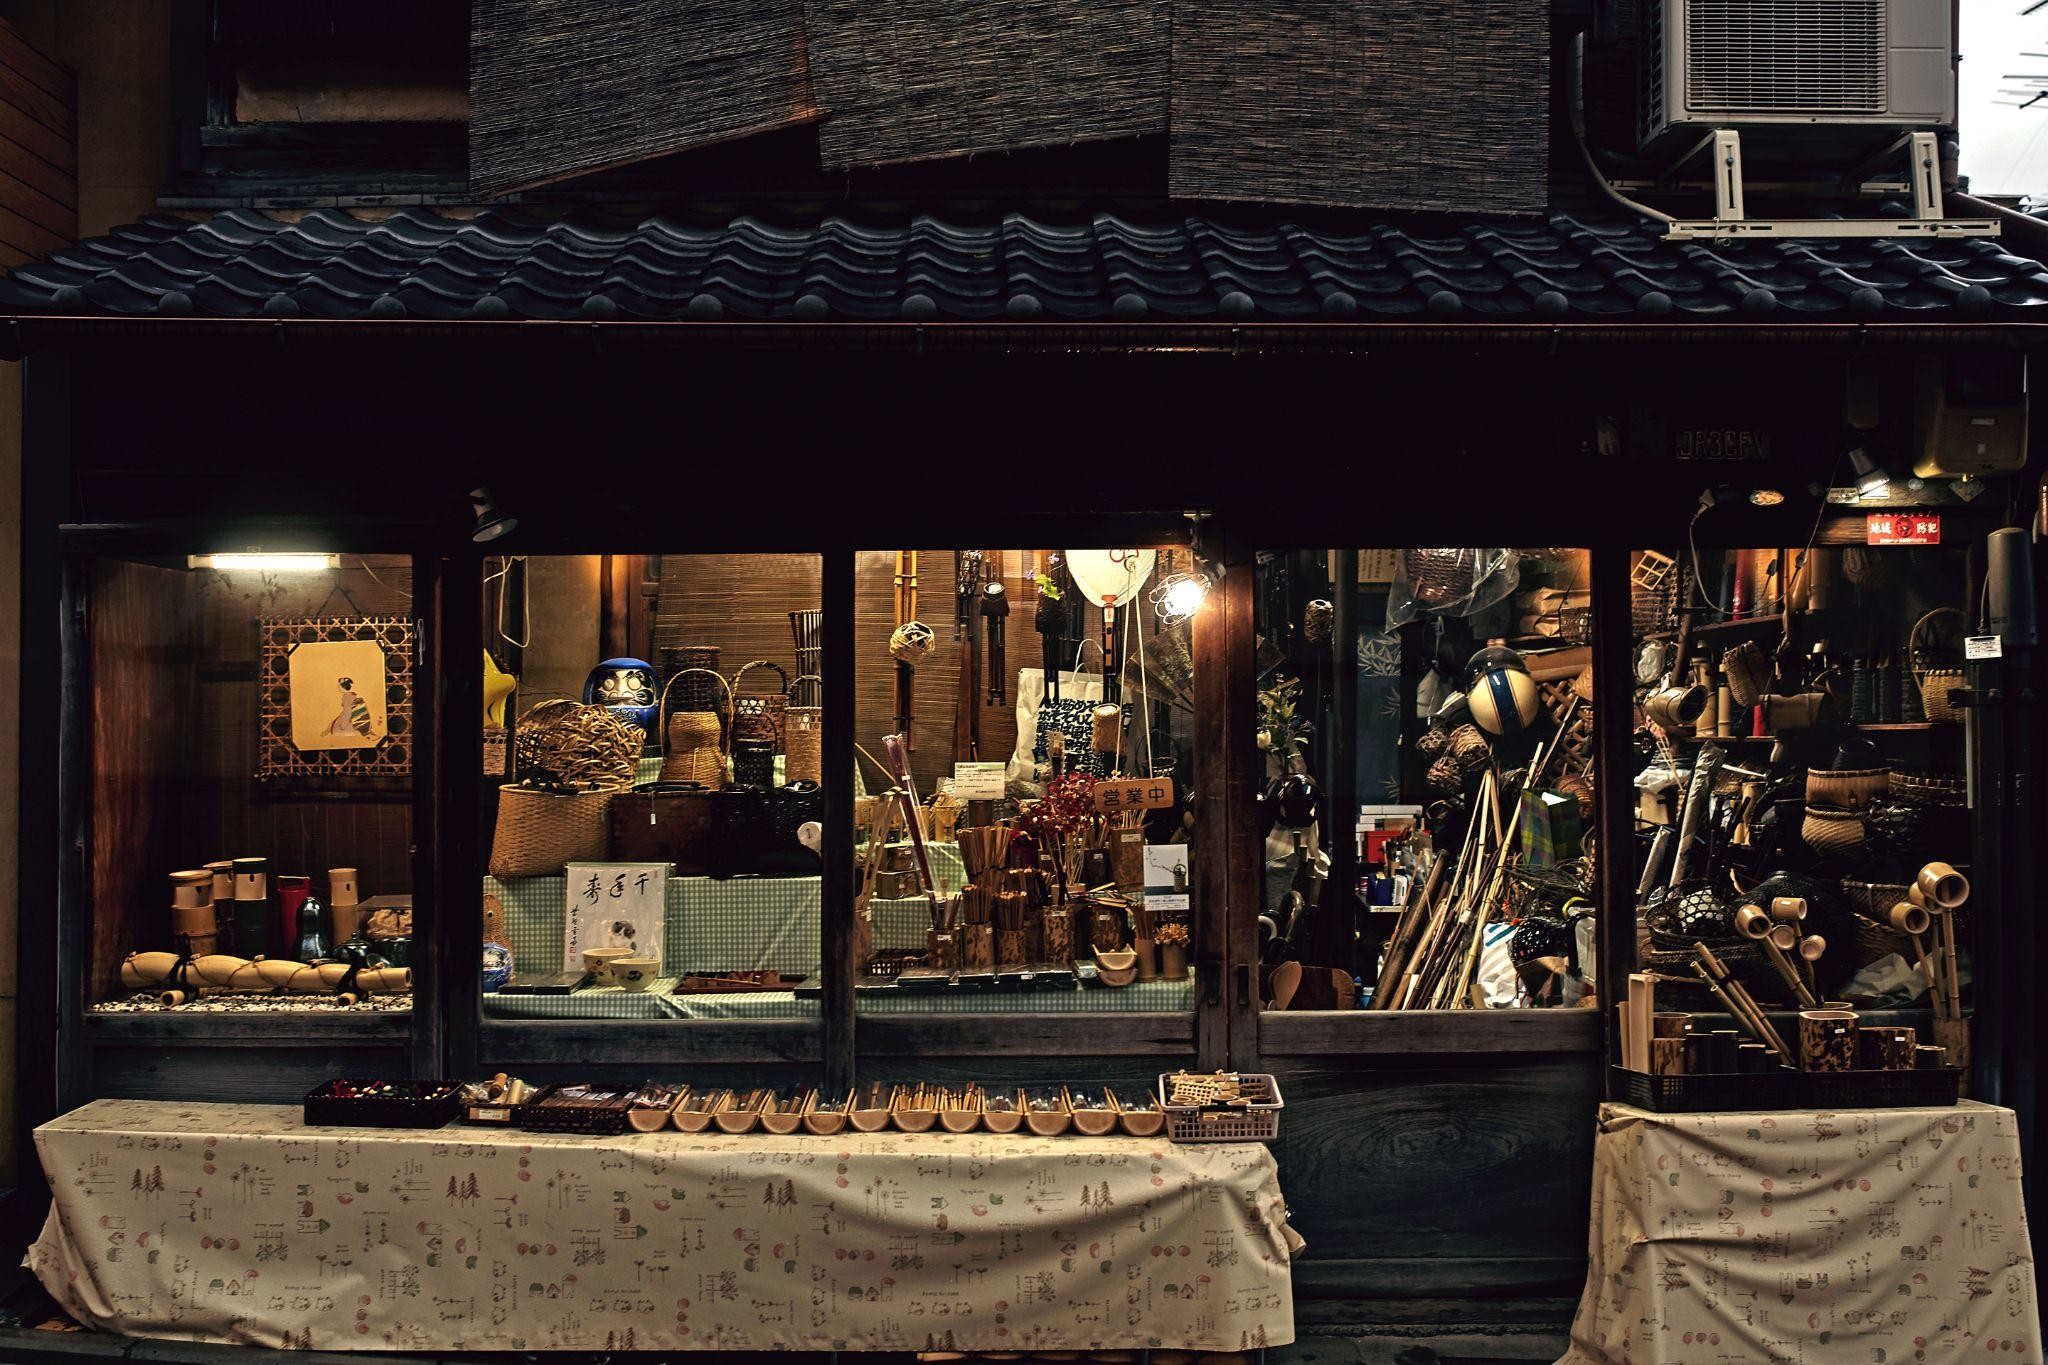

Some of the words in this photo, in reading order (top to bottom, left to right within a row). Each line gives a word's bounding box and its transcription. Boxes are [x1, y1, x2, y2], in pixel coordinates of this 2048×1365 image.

[1916, 521, 1938, 535] 防犯
[1103, 785, 1165, 807] 営業中
